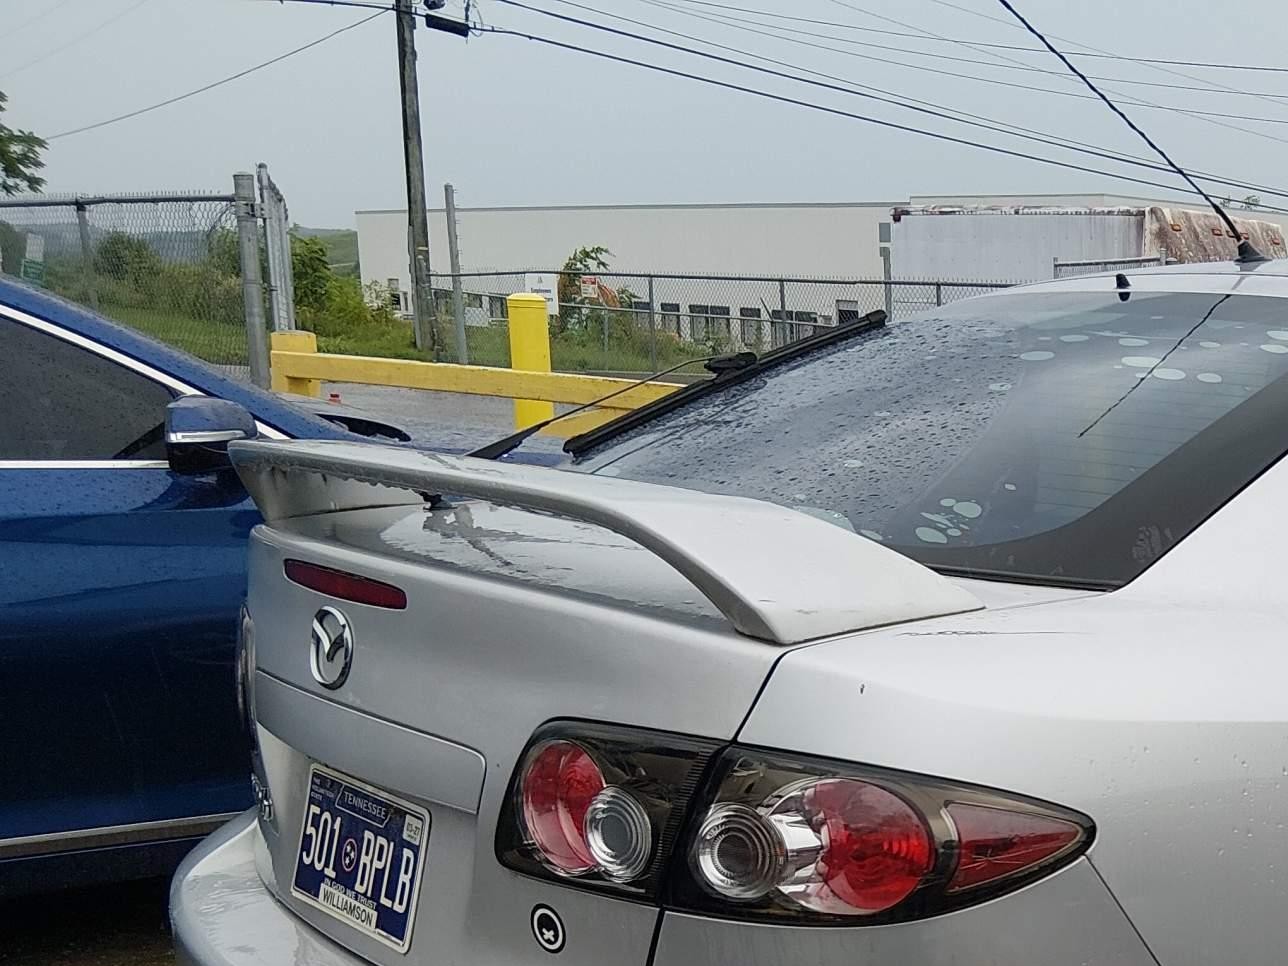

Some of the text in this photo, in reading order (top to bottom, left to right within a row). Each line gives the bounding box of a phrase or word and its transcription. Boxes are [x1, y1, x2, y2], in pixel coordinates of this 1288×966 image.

[343, 791, 387, 820] TENNESSEE
[302, 804, 415, 914] 501 BPLB
[322, 887, 373, 927] WILLIAMSON
[331, 881, 346, 895] GOD
[346, 888, 357, 900] WE
[357, 893, 377, 911] TRUST
